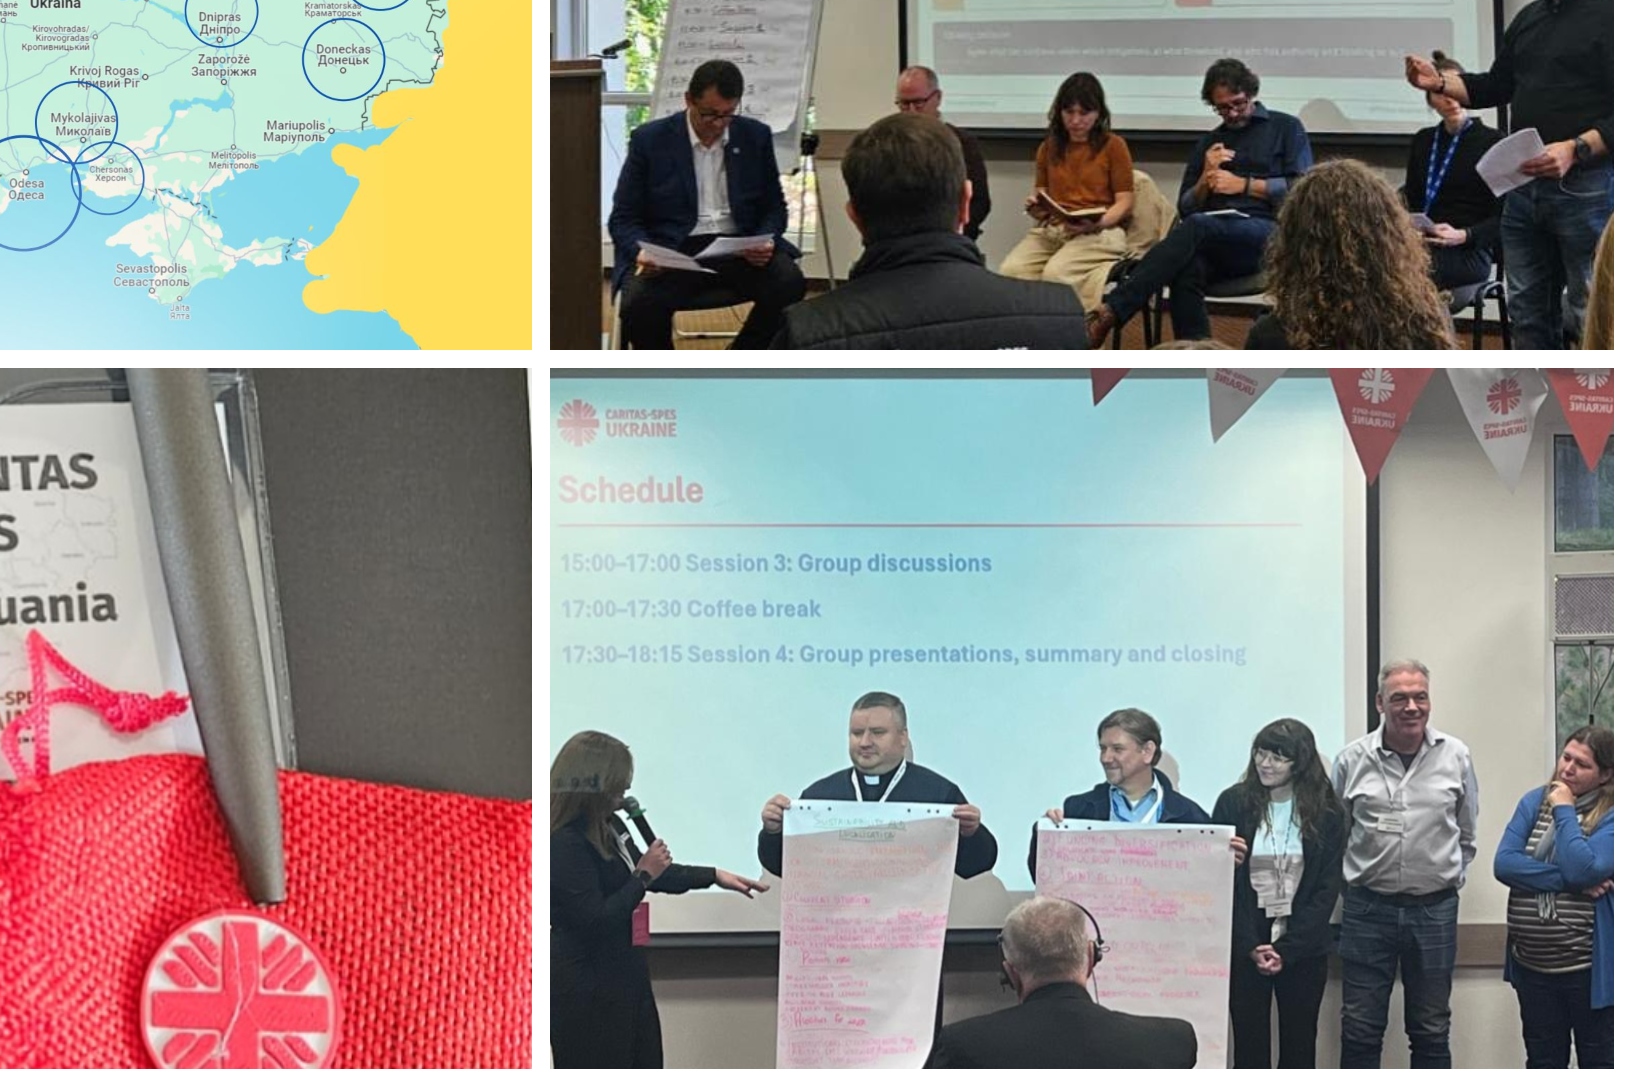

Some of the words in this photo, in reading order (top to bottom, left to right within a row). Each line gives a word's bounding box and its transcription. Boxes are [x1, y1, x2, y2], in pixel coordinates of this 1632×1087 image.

[198, 11, 241, 23] Dnipras
[305, 10, 362, 18] Краматорськ
[199, 24, 241, 38] Дніпро
[36, 34, 90, 43] Kirovogradas
[21, 43, 90, 52] Кропивницький
[317, 44, 371, 54] Doneckas
[197, 52, 251, 67] Zaporožė
[318, 55, 369, 66] Донецьк
[70, 66, 101, 77] Krivoj
[105, 66, 139, 77] Rogas
[191, 65, 257, 79] Запоріжжя
[78, 78, 120, 89] Кривий
[124, 78, 140, 88] Ріг
[50, 112, 116, 124] Mykolajivas
[55, 126, 111, 137] Миколаїв
[266, 120, 326, 133] Mariupolis
[263, 131, 326, 145] Маріуполь
[211, 152, 256, 162] Melitopolis
[89, 166, 133, 174] Chersonas
[209, 161, 259, 170] Мелітополь
[9, 178, 44, 188] Odesa
[95, 174, 127, 183] Херсон
[8, 190, 44, 201] Одеса
[116, 263, 187, 275] Sevastopolis
[114, 277, 189, 287] Севастополь
[605, 409, 677, 421] CARITAS-SPES
[606, 422, 677, 438] UKRAINE
[558, 475, 704, 503] Schedule
[686, 552, 769, 573] Session
[774, 553, 792, 572] 3:
[798, 553, 862, 578] Group
[867, 552, 992, 573] discussions
[687, 598, 758, 619] Coffee
[762, 598, 822, 619] break
[688, 644, 771, 664] Session
[776, 645, 794, 664] 4:
[800, 644, 864, 669] Group
[869, 644, 1019, 669] presentations,
[1025, 649, 1123, 669] summary
[1128, 644, 1166, 664] and
[1171, 644, 1247, 669] closing
